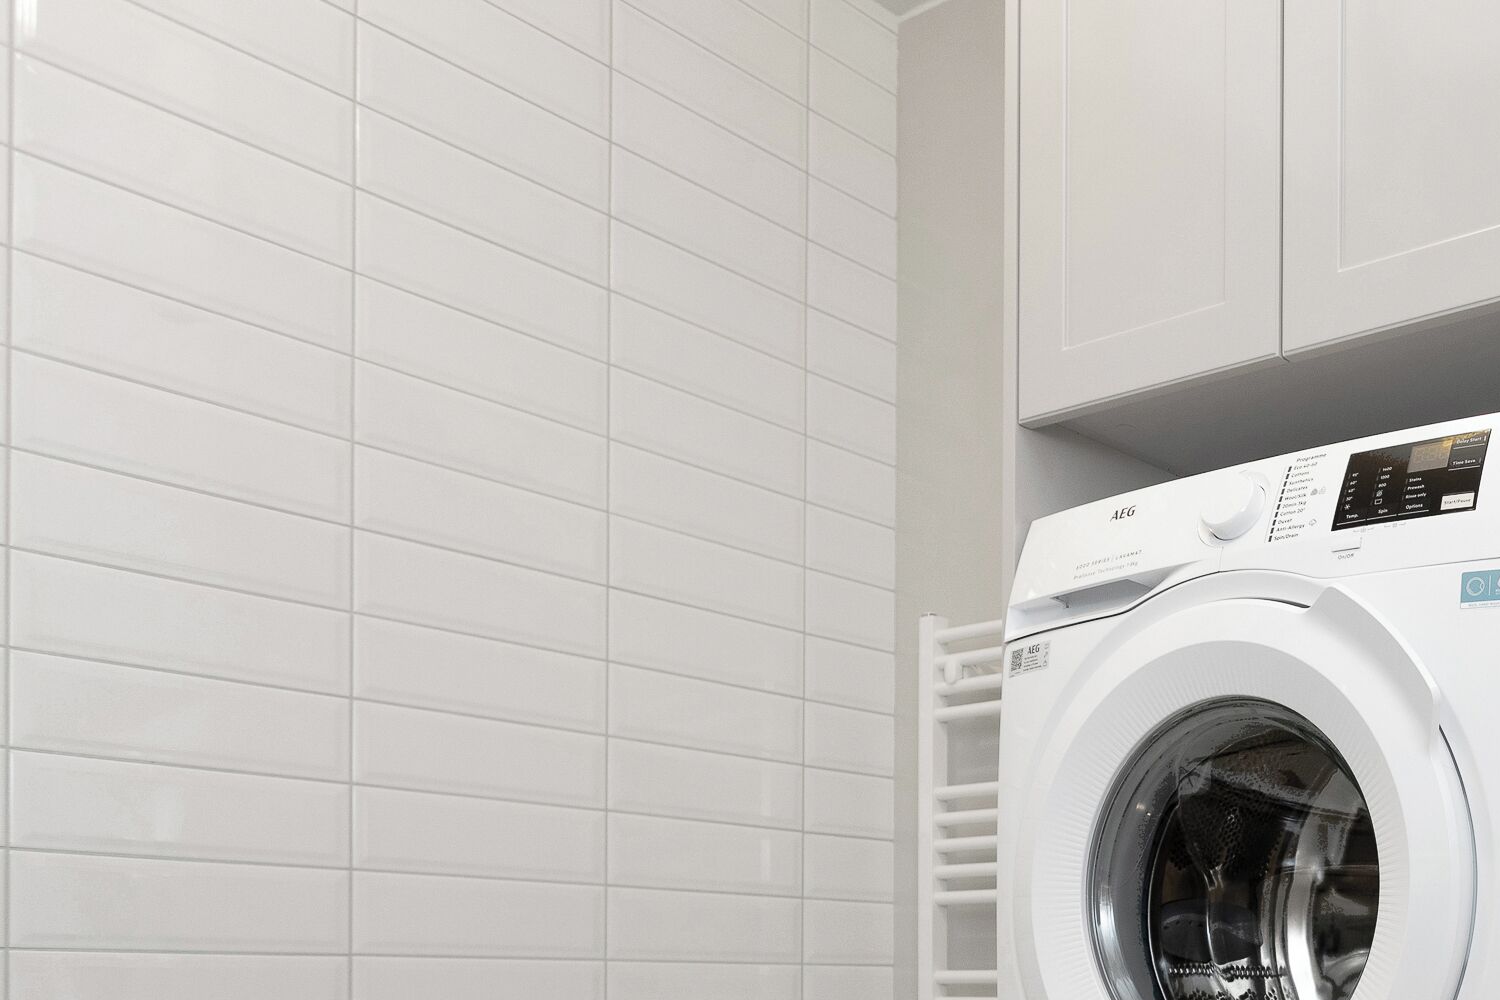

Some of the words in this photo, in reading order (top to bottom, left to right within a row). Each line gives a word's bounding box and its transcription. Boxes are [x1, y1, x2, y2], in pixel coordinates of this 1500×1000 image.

[1296, 453, 1327, 462] Programme
[1109, 504, 1137, 522] AEG
[1028, 643, 1040, 654] AEG
